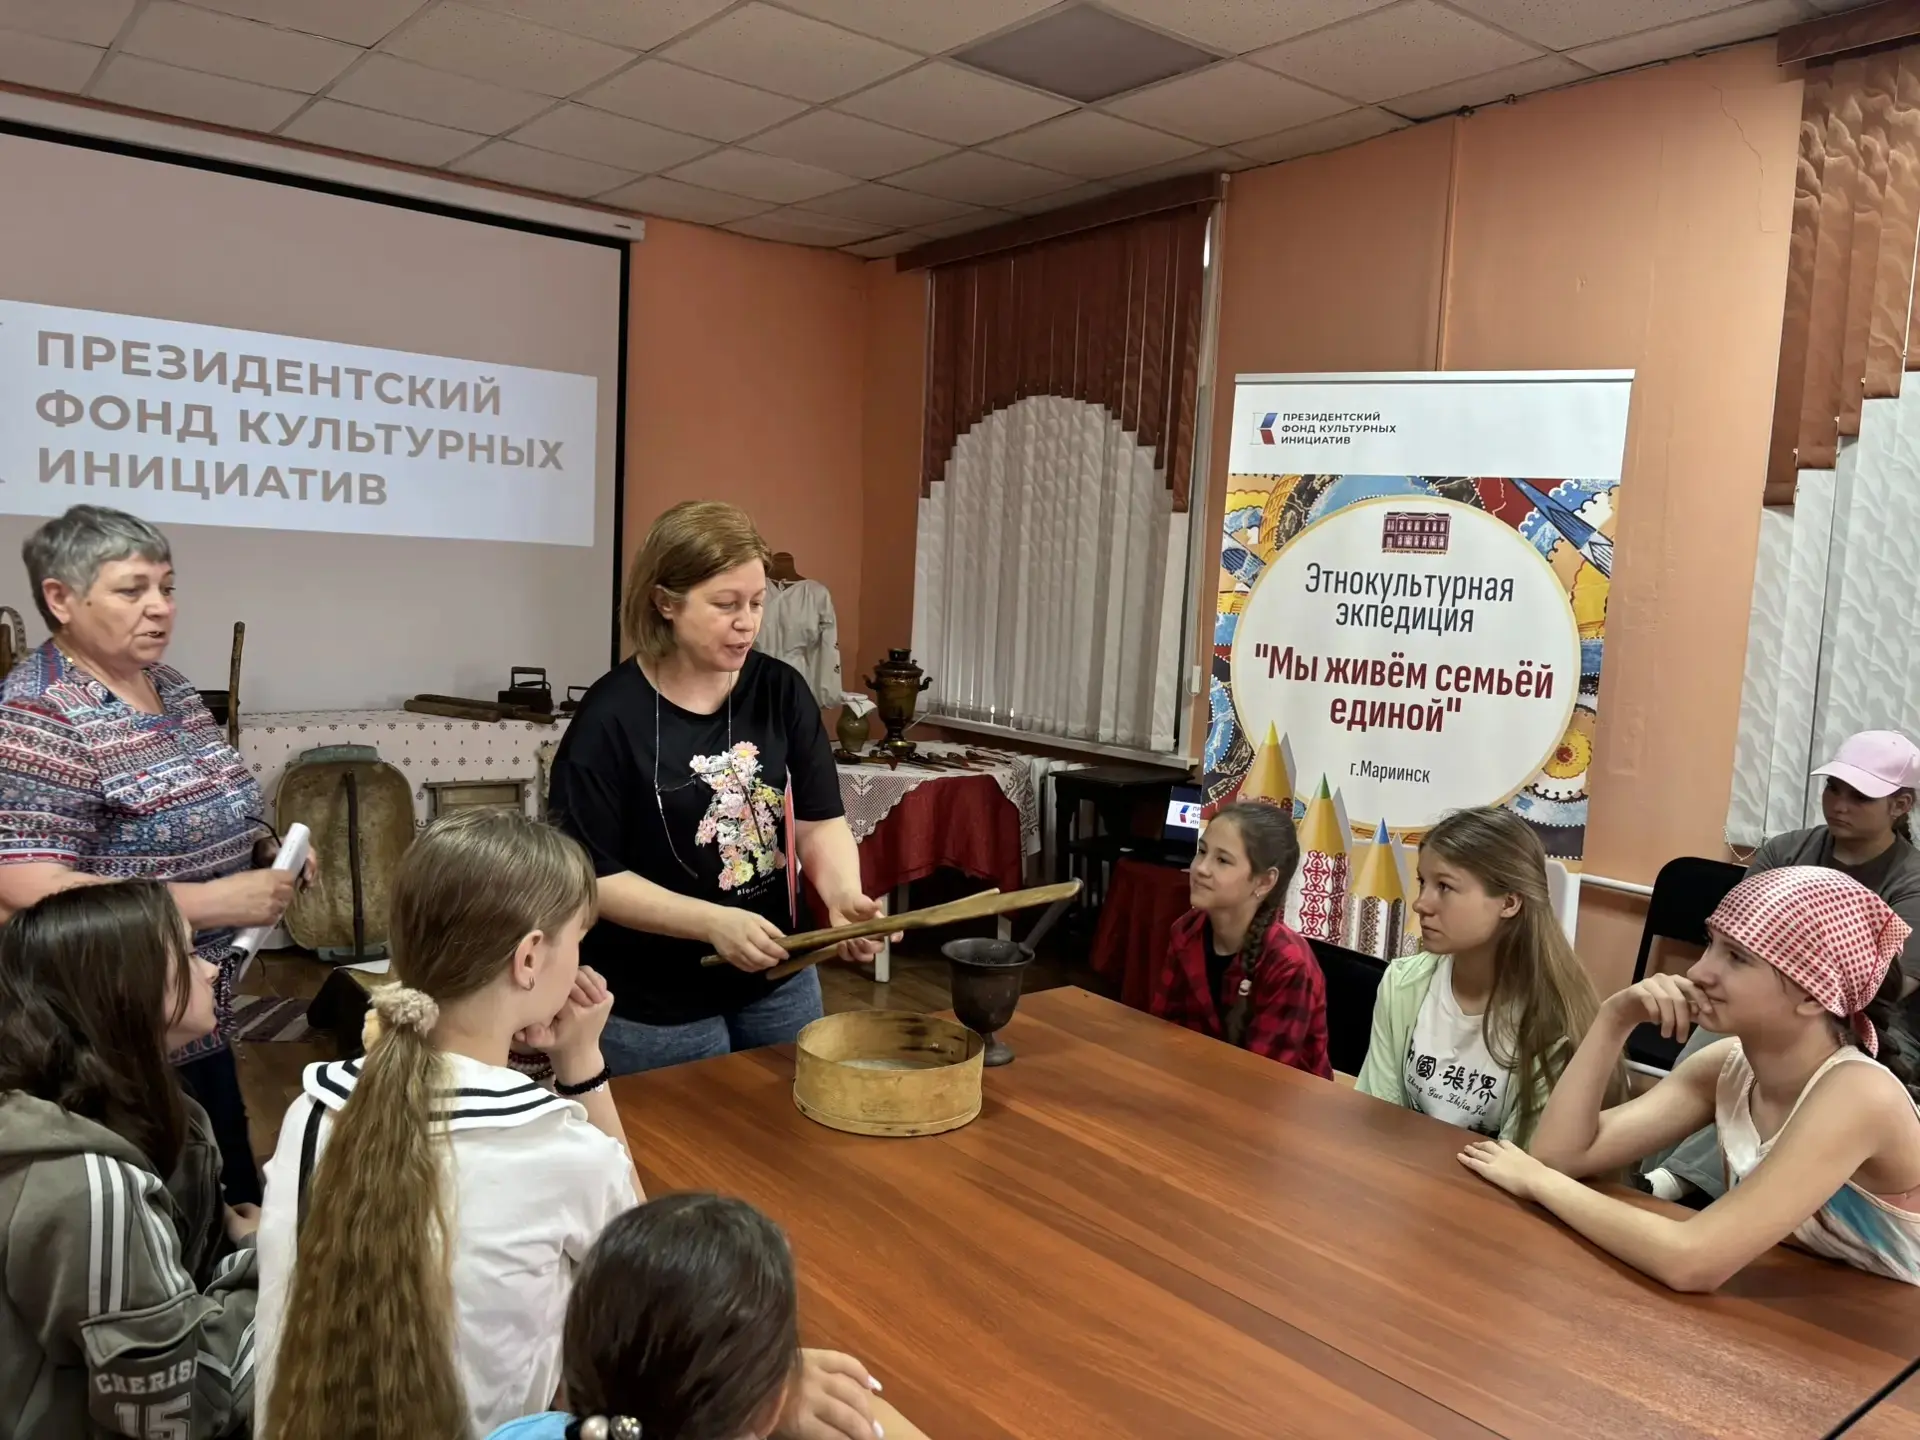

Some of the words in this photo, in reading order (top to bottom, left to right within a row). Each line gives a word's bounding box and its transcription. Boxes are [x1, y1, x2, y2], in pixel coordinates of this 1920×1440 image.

[37, 330, 501, 416] ПРЕЗИДЕНТСКИЙ
[35, 389, 218, 446] ФОНД
[239, 409, 564, 471] КУЛЬТУРНЫХ
[1281, 424, 1316, 434] ФОНД
[1319, 424, 1397, 434] КУЛЬТУРНЫХ
[1282, 411, 1381, 422] ПРЕЗИДЕНТСКИЙ
[1281, 436, 1351, 445] ИНИЦИАТИВ
[38, 447, 388, 506] ИНИЦИАТИВ
[1305, 562, 1514, 607] Этнокультурная
[1335, 602, 1475, 636] экпедиция
[1254, 643, 1318, 682] "Мы
[1324, 651, 1427, 690] живём
[1435, 660, 1554, 699] семьёй
[1330, 697, 1462, 733] единой"
[1350, 760, 1431, 783] г.Мариинск
[114, 1391, 191, 1440] 15
